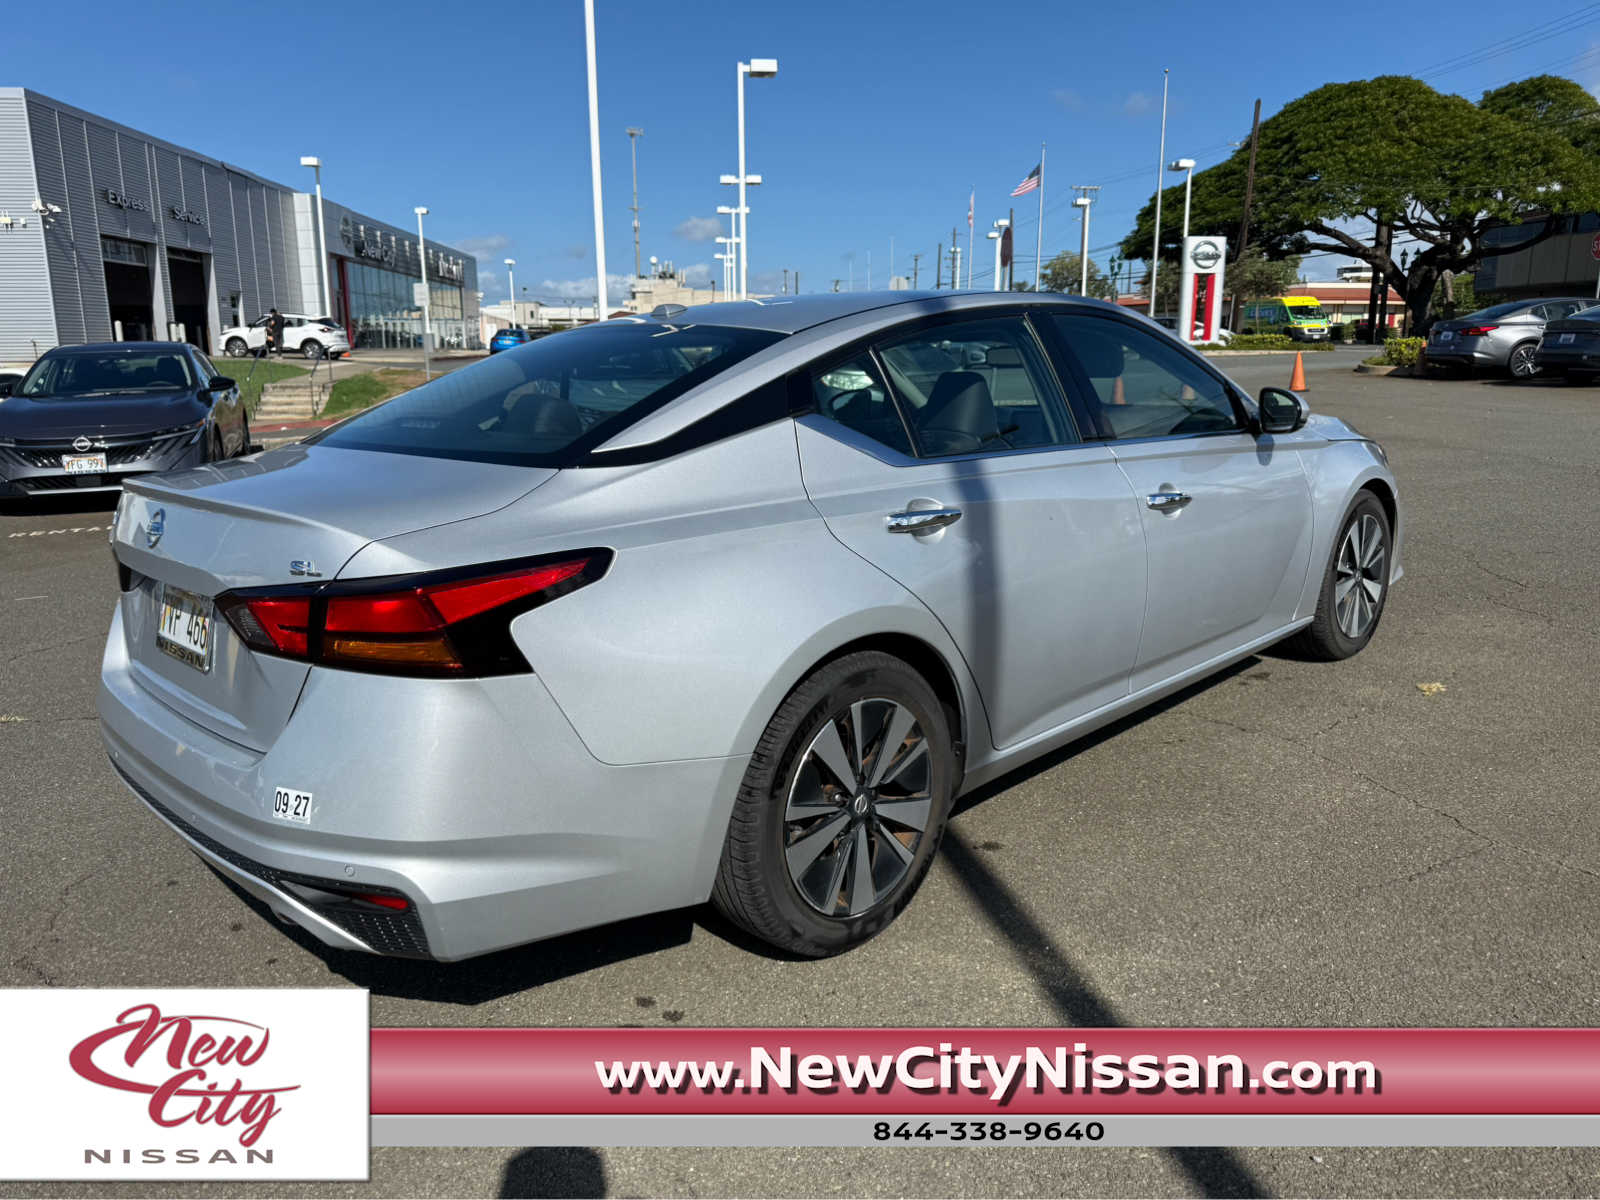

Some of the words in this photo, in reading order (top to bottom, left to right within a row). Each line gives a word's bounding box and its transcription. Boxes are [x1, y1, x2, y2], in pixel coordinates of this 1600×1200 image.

[106, 189, 150, 212] Express
[171, 206, 206, 225] Service
[290, 560, 322, 577] SL
[187, 613, 208, 649] 466
[156, 634, 206, 668] NISSAN
[275, 791, 289, 813] 09
[294, 795, 310, 817] 27
